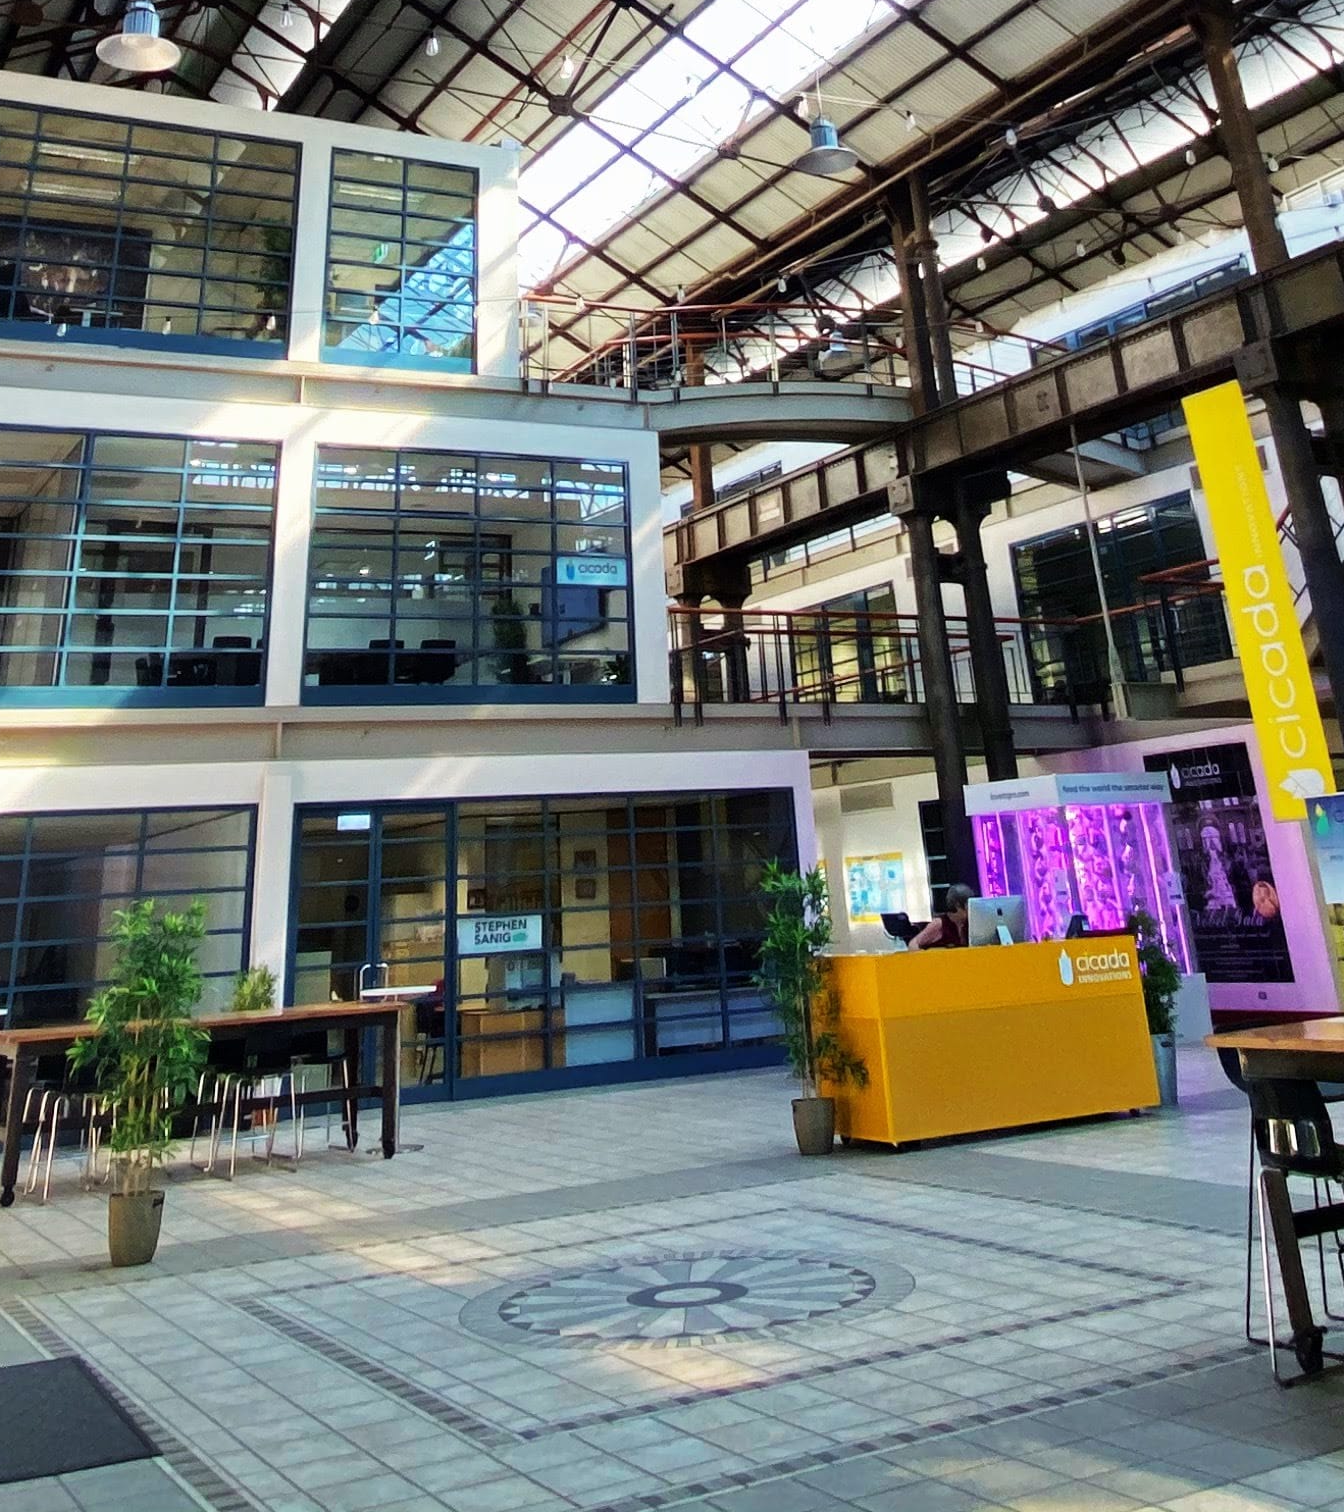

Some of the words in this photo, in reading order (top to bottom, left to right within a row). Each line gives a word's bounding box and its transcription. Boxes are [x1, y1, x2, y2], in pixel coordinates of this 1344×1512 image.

[1240, 564, 1308, 759] cicada
[474, 918, 527, 934] STEPHEN
[474, 932, 511, 945] SANIG
[1076, 948, 1130, 971] cicada
